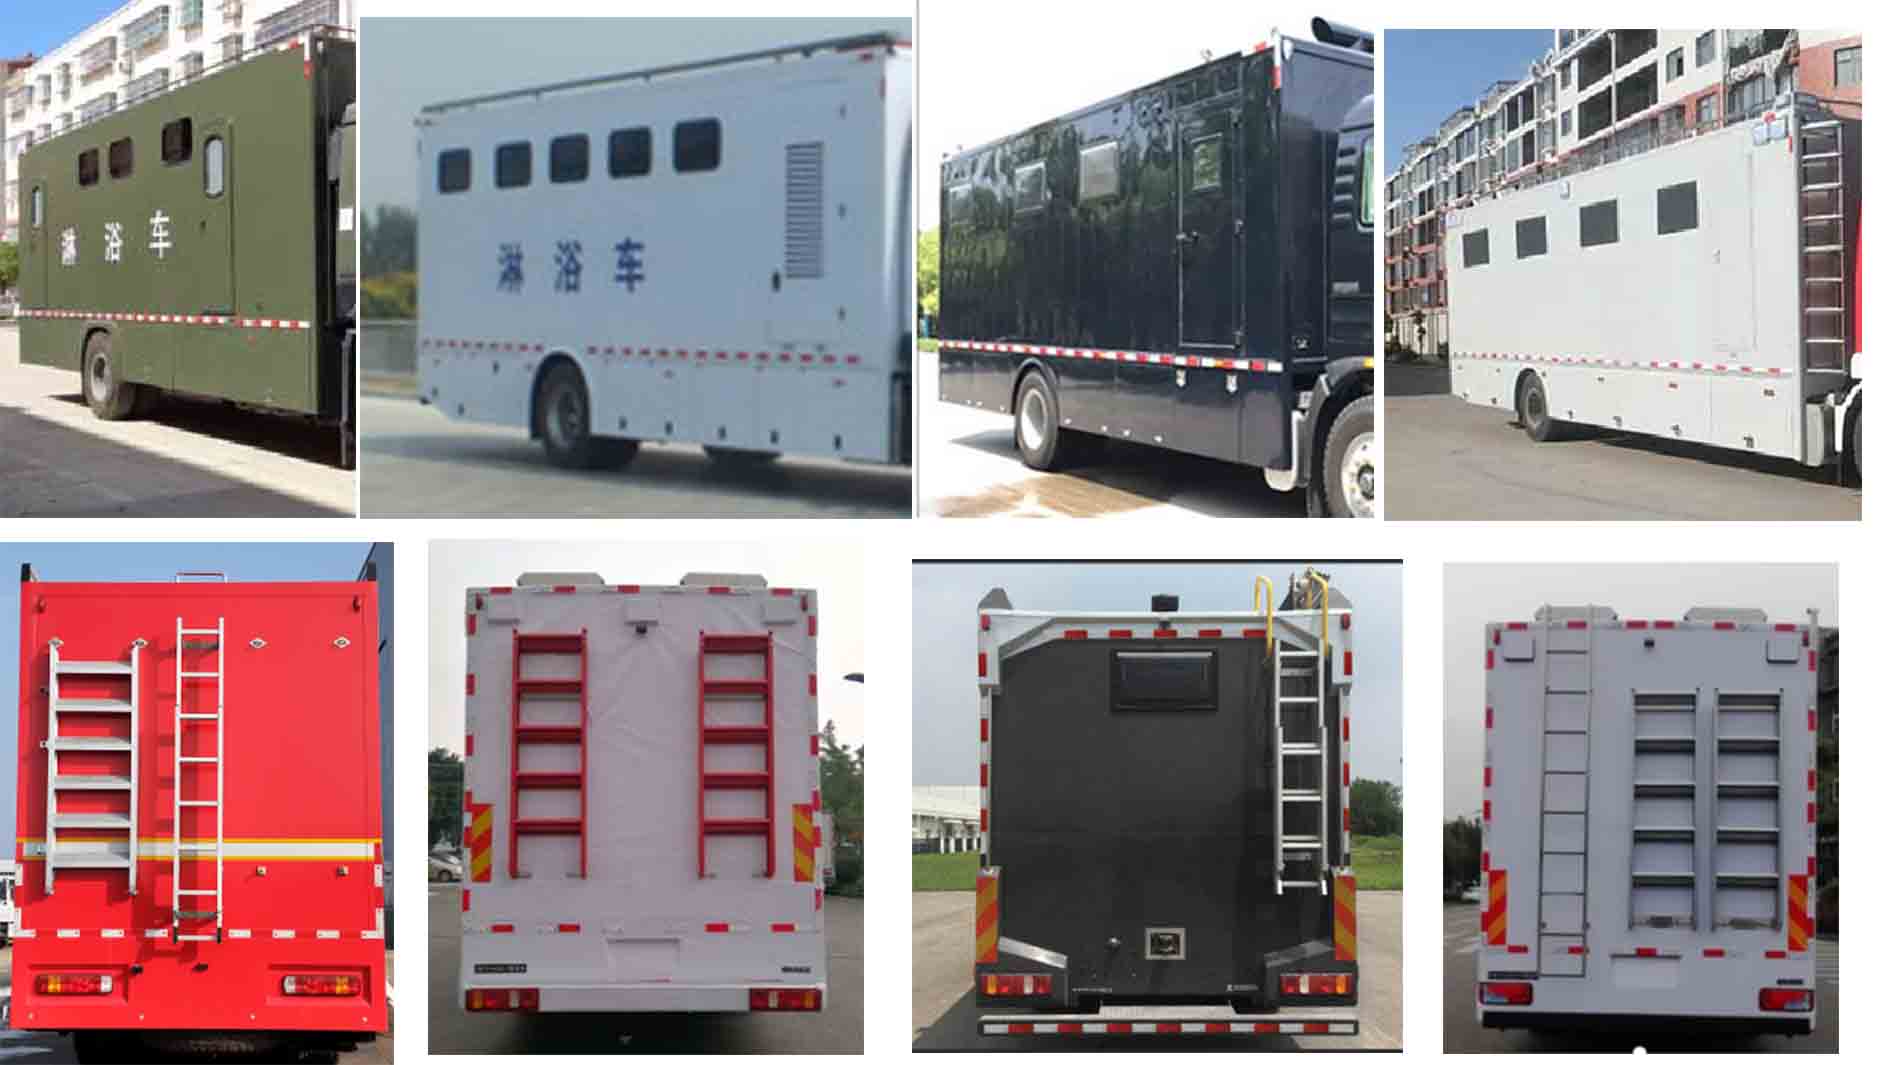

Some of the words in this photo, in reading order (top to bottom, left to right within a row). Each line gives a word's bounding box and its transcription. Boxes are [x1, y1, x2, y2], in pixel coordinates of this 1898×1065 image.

[61, 209, 172, 266] 淋浴车
[497, 238, 645, 293] 淋浴车
